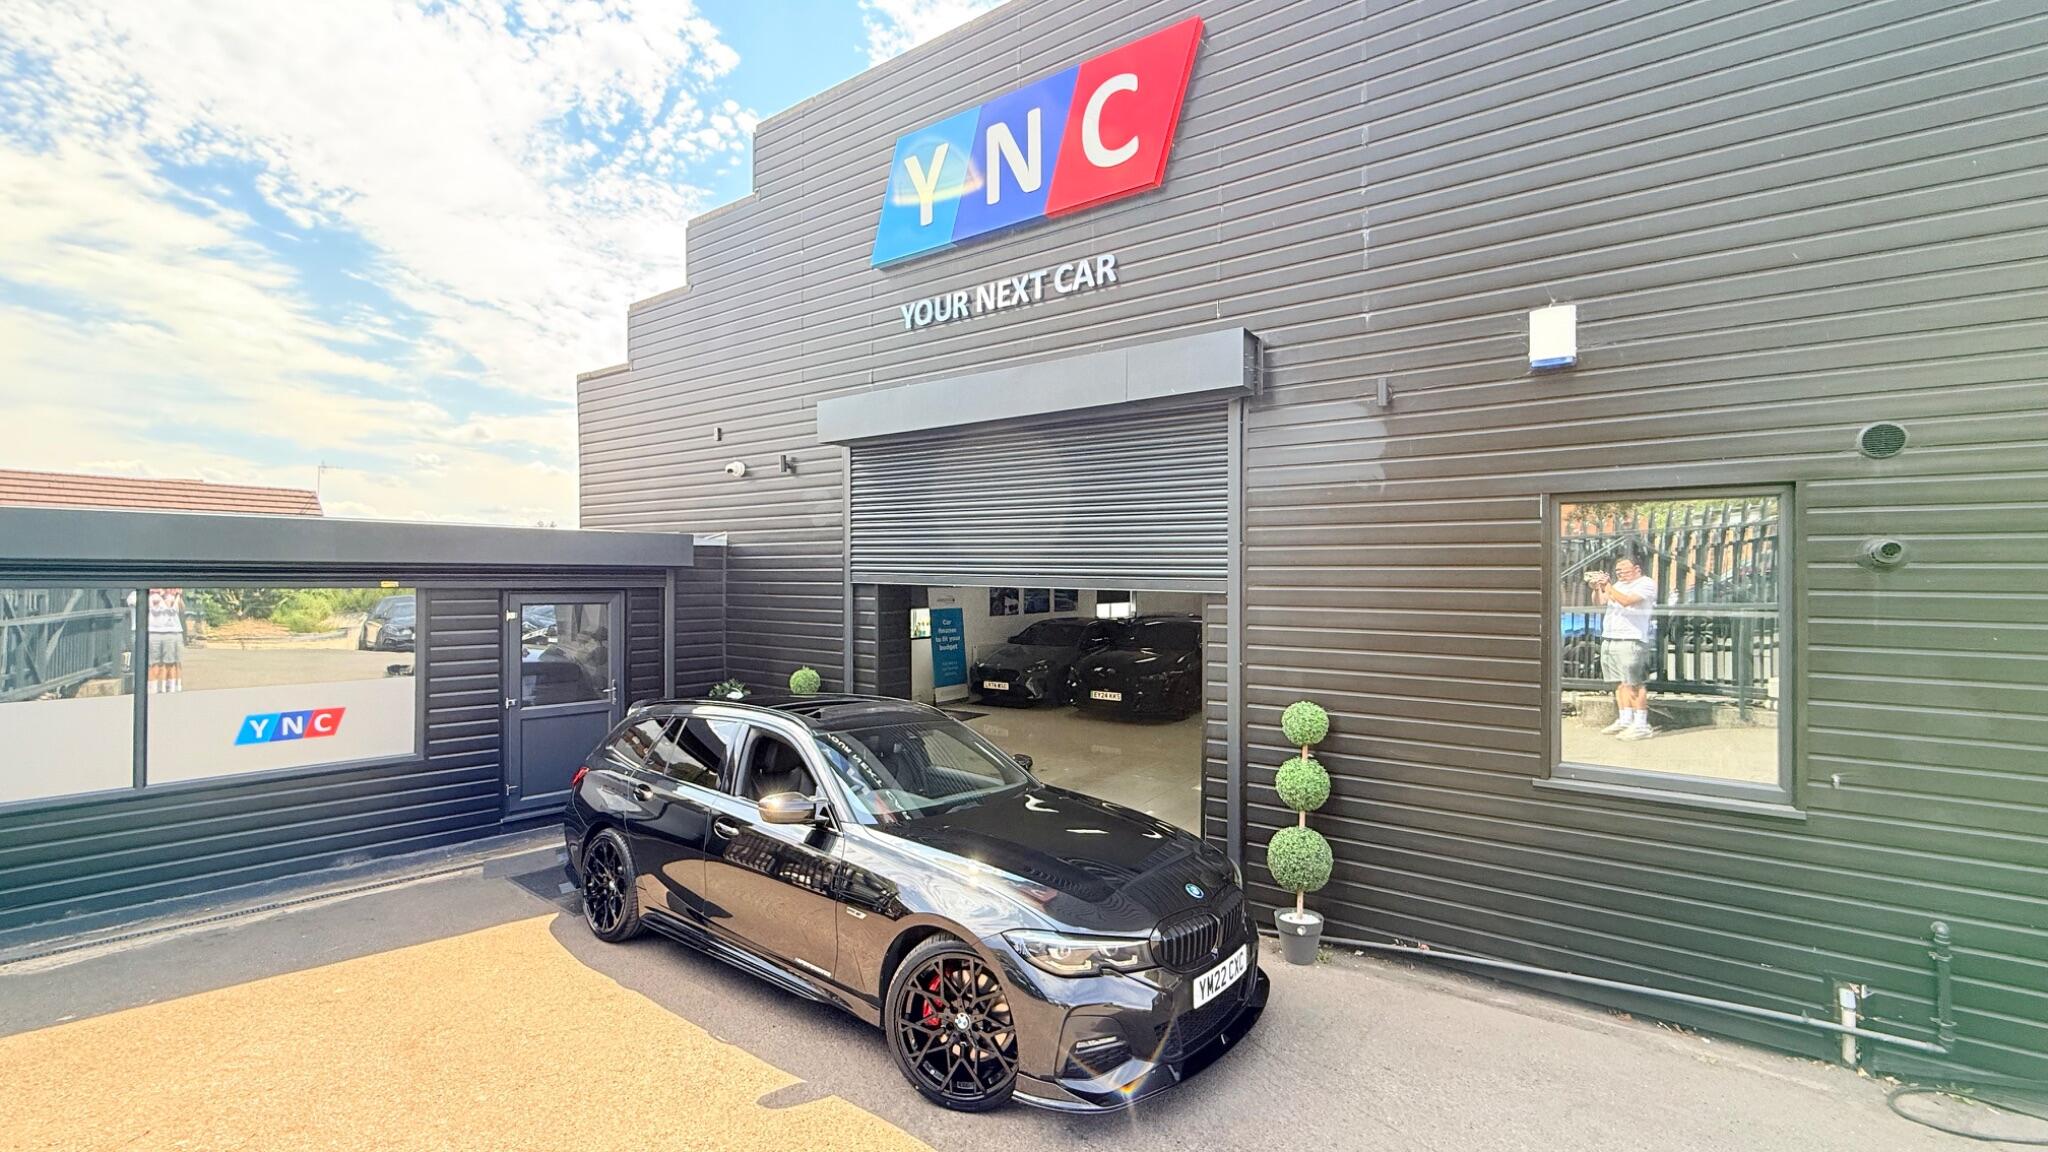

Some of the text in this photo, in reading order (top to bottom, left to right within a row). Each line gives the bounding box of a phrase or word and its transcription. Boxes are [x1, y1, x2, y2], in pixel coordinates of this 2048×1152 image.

[904, 73, 1140, 226] YNC
[900, 254, 1117, 329] YOUR NEXT CAR
[248, 713, 333, 739] YNC
[1199, 951, 1244, 1001] YM22 CXC
